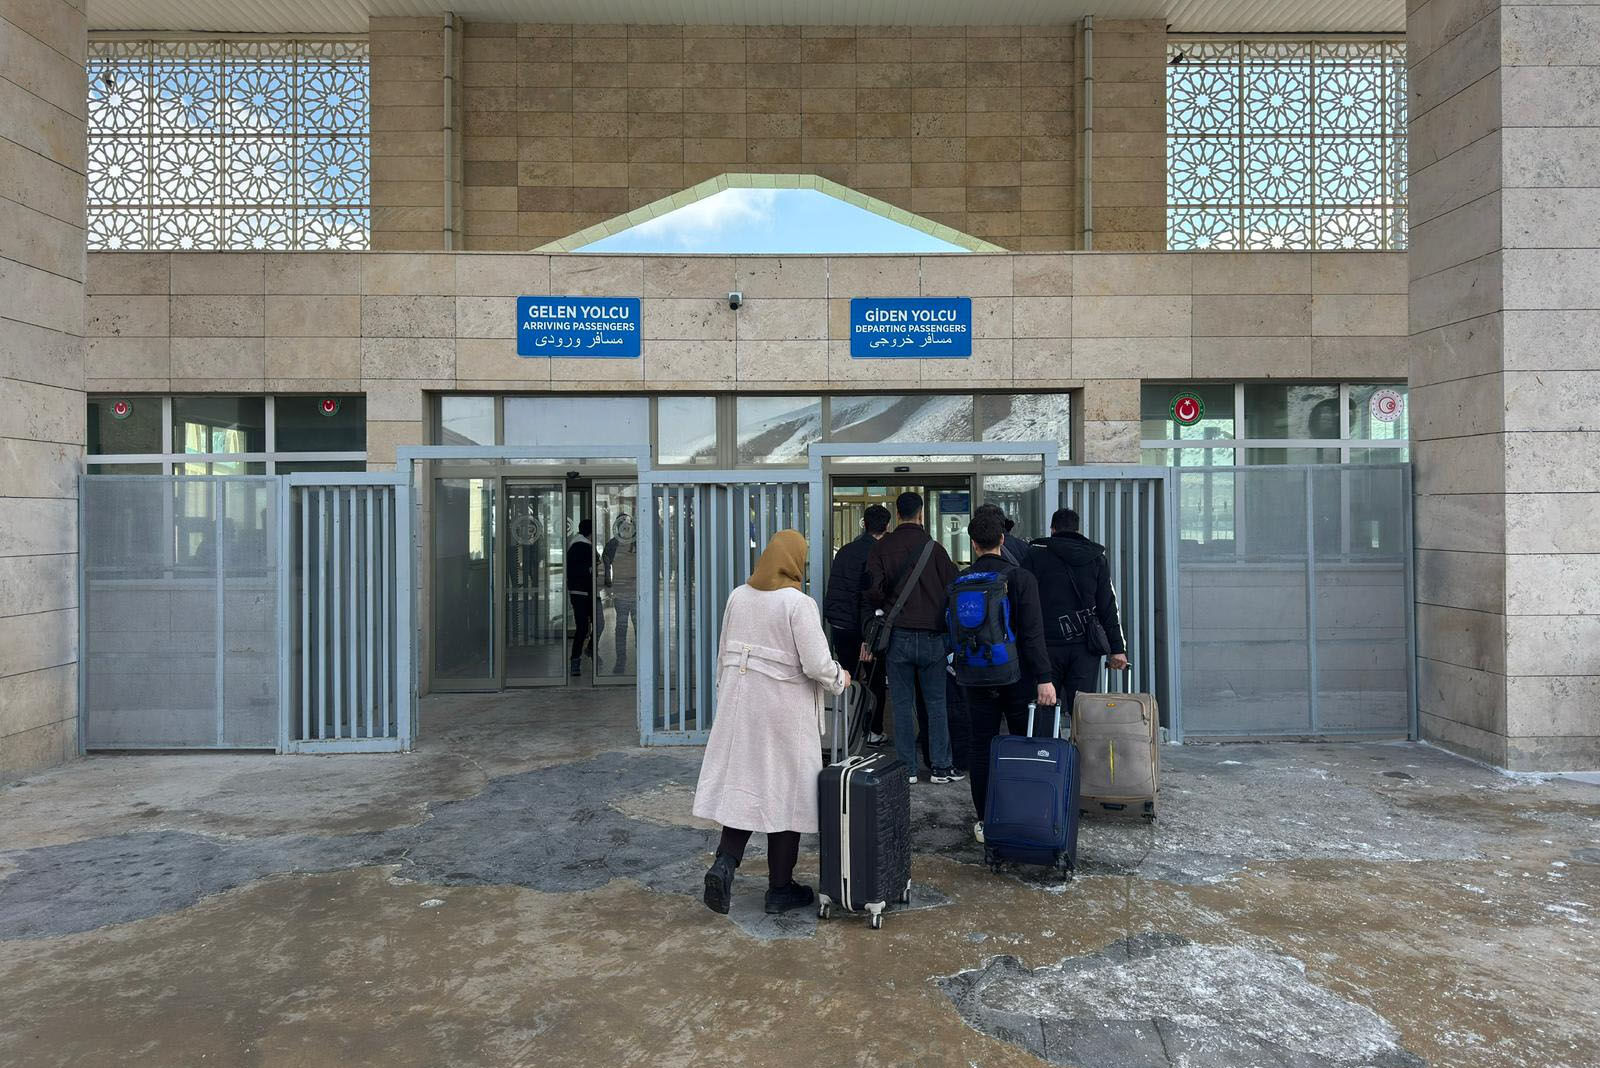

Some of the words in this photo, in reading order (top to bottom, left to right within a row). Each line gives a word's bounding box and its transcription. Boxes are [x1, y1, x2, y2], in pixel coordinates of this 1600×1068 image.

[528, 305, 577, 318] GELEN
[580, 306, 629, 319] YOLCU
[865, 308, 908, 322] GİDEN
[911, 309, 957, 322] YOLCU
[523, 321, 571, 330] ARRIVING
[572, 322, 635, 331] PASSENGERS
[855, 324, 907, 333] DEPARTING
[908, 324, 967, 333] PASSENGERS
[586, 331, 624, 348] مسافر
[919, 332, 952, 348] مسافر
